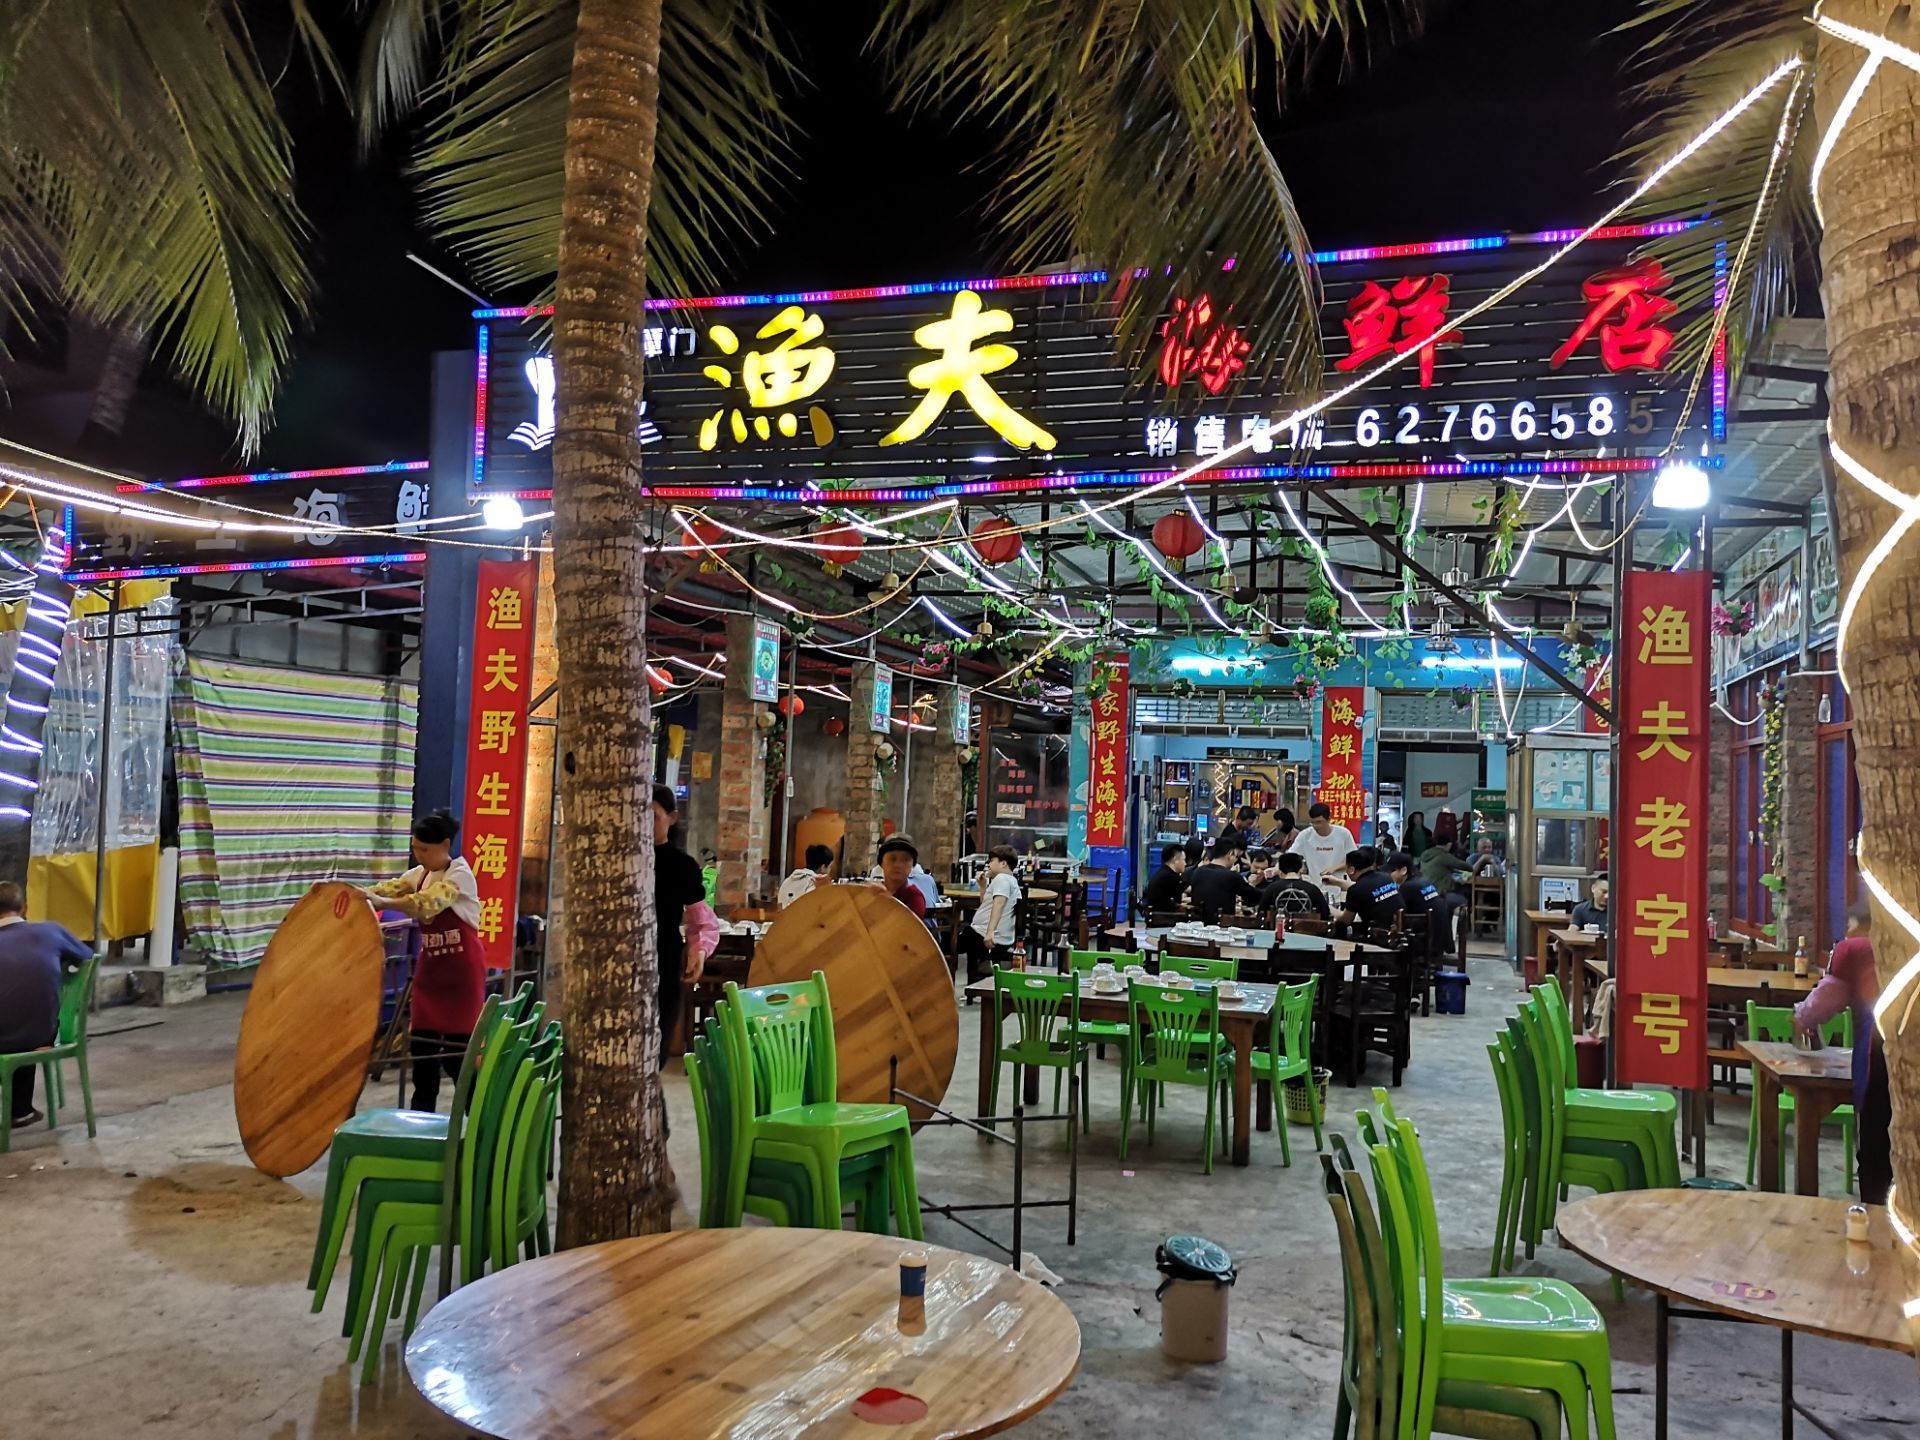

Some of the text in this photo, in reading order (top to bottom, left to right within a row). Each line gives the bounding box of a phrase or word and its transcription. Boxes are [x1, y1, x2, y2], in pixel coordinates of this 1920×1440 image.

[1356, 395, 1655, 448] 62766585
[472, 586, 524, 943] 渔夫野生海鲜
[1326, 697, 1356, 827] 海鲜批
[1632, 605, 1693, 1055] 渔夫老字号
